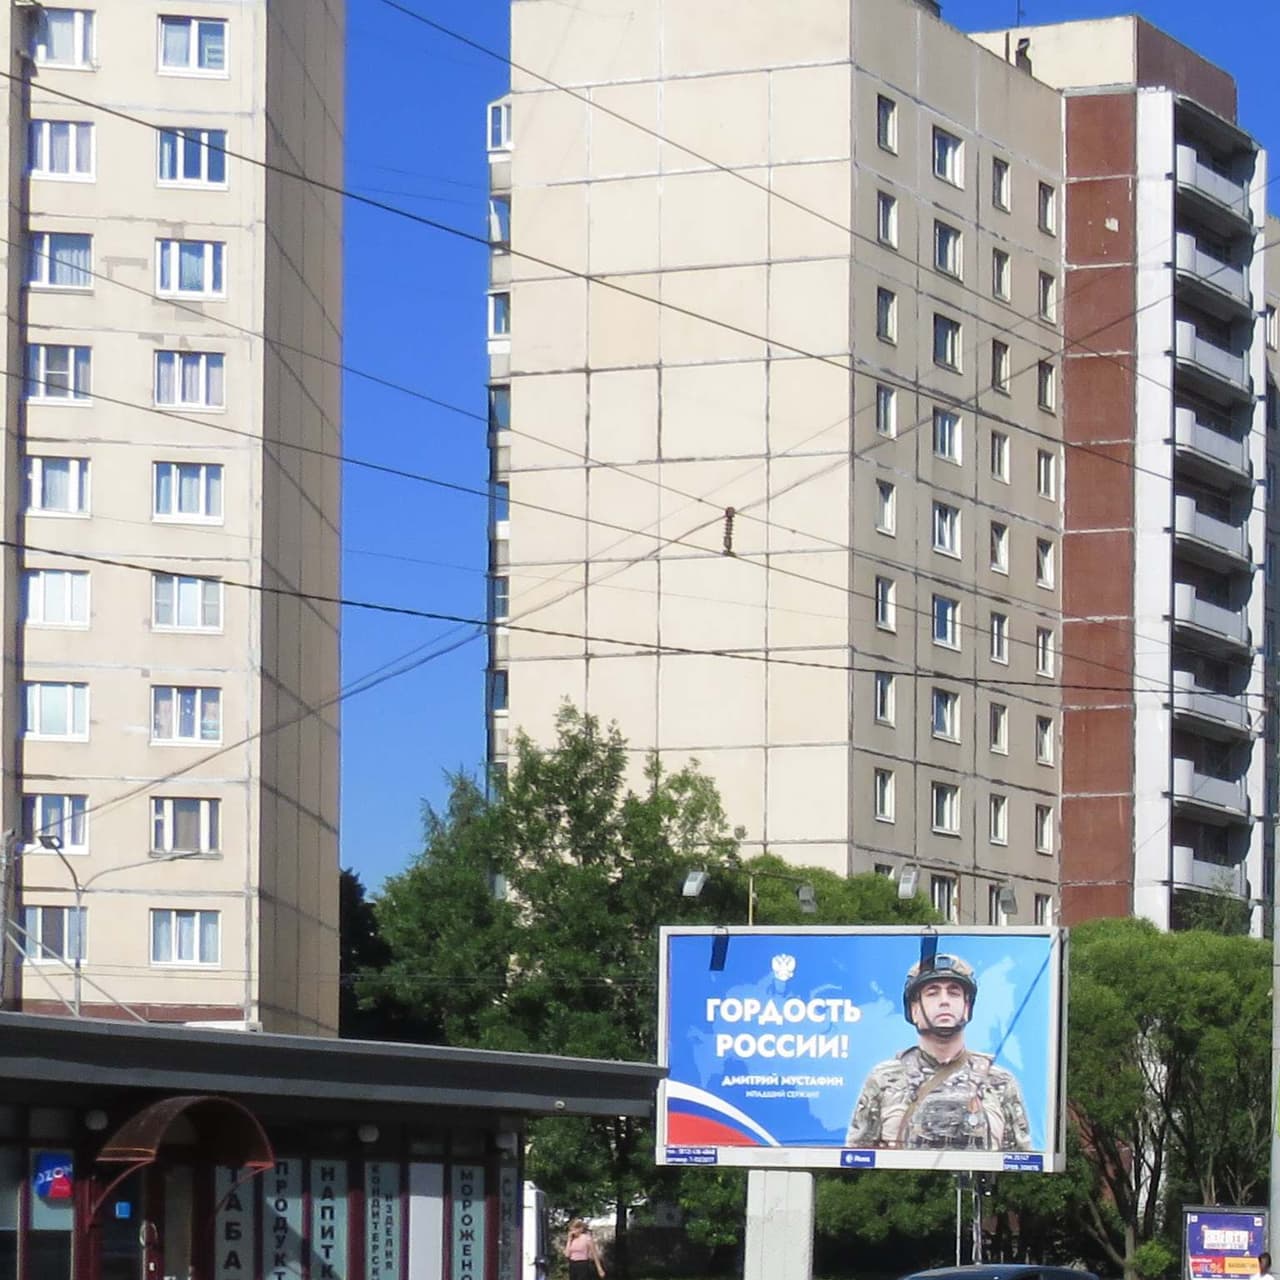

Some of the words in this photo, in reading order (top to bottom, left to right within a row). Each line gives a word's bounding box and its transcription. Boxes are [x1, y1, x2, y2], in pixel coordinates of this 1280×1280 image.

[706, 998, 862, 1026] ГОРДОСТЬ
[716, 1033, 849, 1059] РОССИИ!
[722, 1073, 779, 1087] ДМИТРИЙ
[781, 1075, 844, 1087] МУСТАФИН
